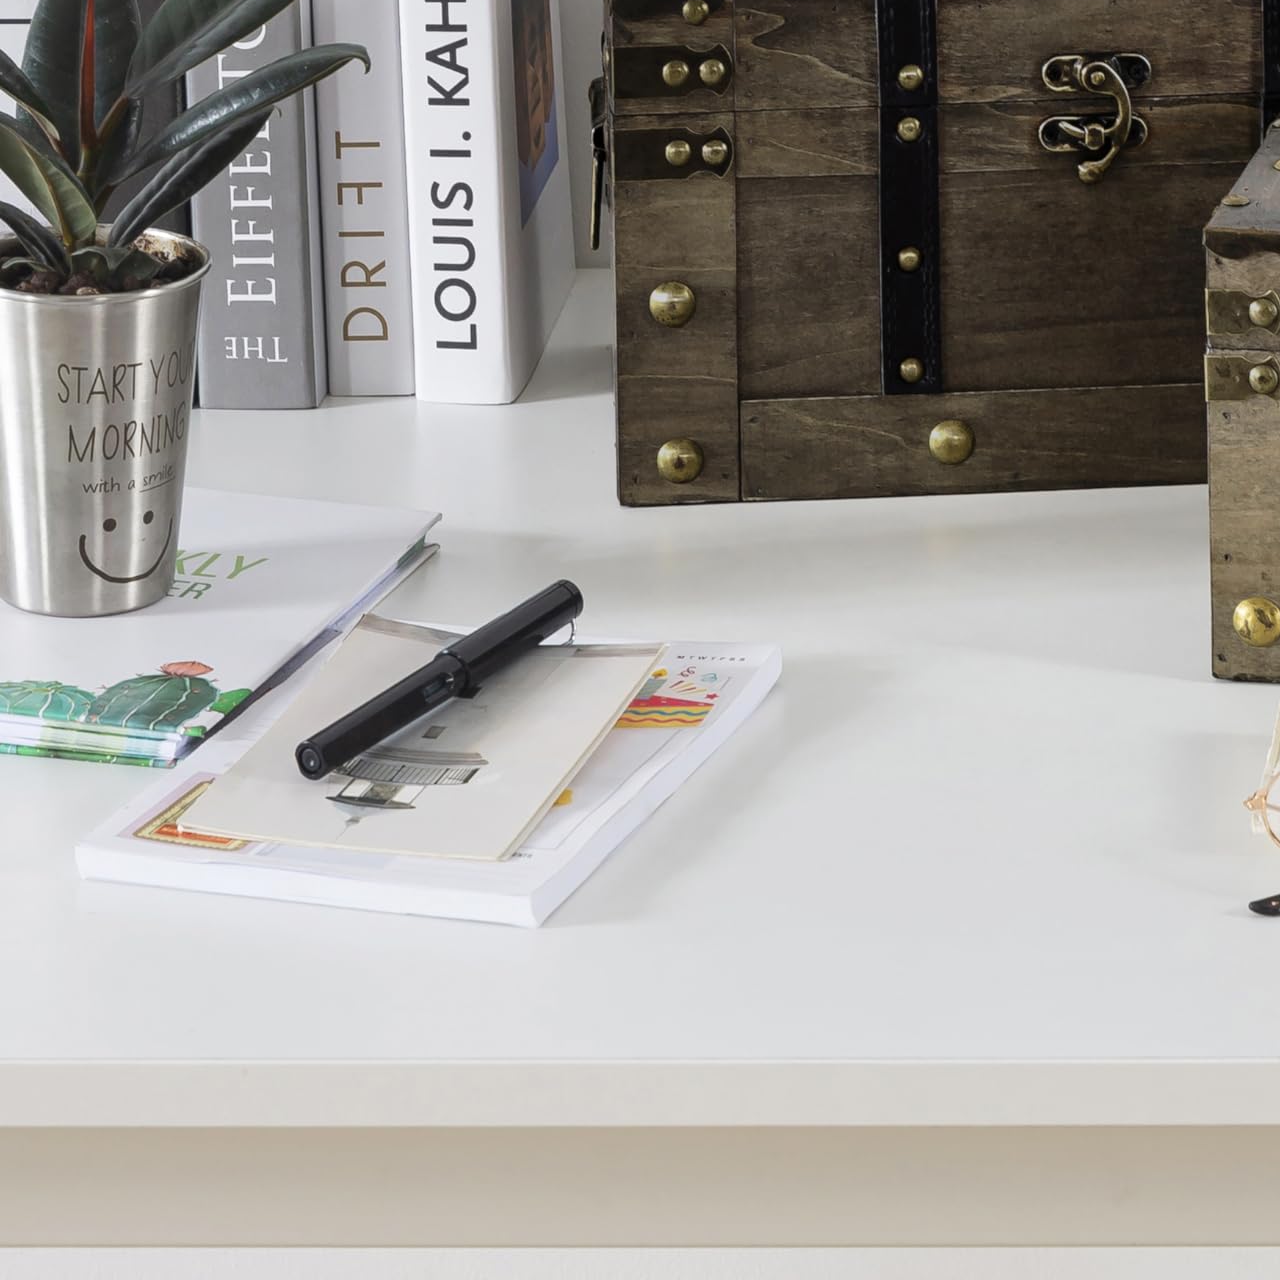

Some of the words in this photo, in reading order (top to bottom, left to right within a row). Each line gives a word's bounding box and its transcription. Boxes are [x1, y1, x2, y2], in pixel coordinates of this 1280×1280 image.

[429, 130, 472, 158] I.
[335, 130, 389, 342] DRIFT
[429, 180, 478, 350] LOUIS
[57, 363, 144, 405] START
[150, 348, 193, 395] YOU
[224, 335, 289, 363] THE
[67, 401, 187, 463] MORNING
[82, 477, 121, 494] with
[127, 479, 136, 490] a
[143, 463, 175, 487] smile
